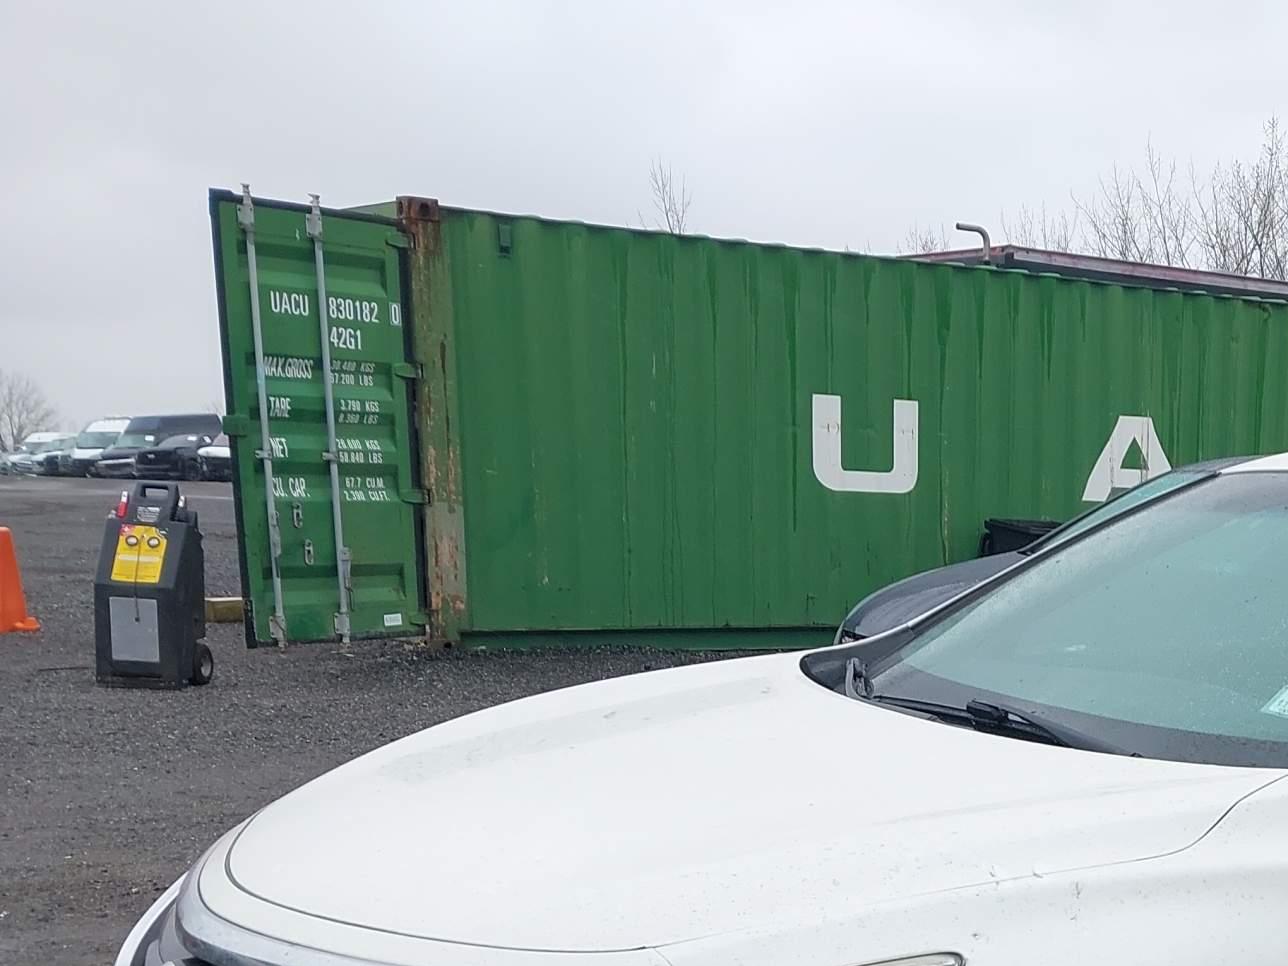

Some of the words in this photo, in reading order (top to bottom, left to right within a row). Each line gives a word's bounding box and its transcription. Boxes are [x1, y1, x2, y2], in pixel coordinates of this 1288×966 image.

[270, 290, 310, 316] UACU
[328, 297, 379, 323] 830182
[390, 302, 401, 326] 0
[330, 326, 362, 351] 42G1
[269, 396, 292, 418] TARE
[365, 401, 380, 413] KGS
[269, 437, 289, 458] NET
[289, 477, 311, 498] CAP.
